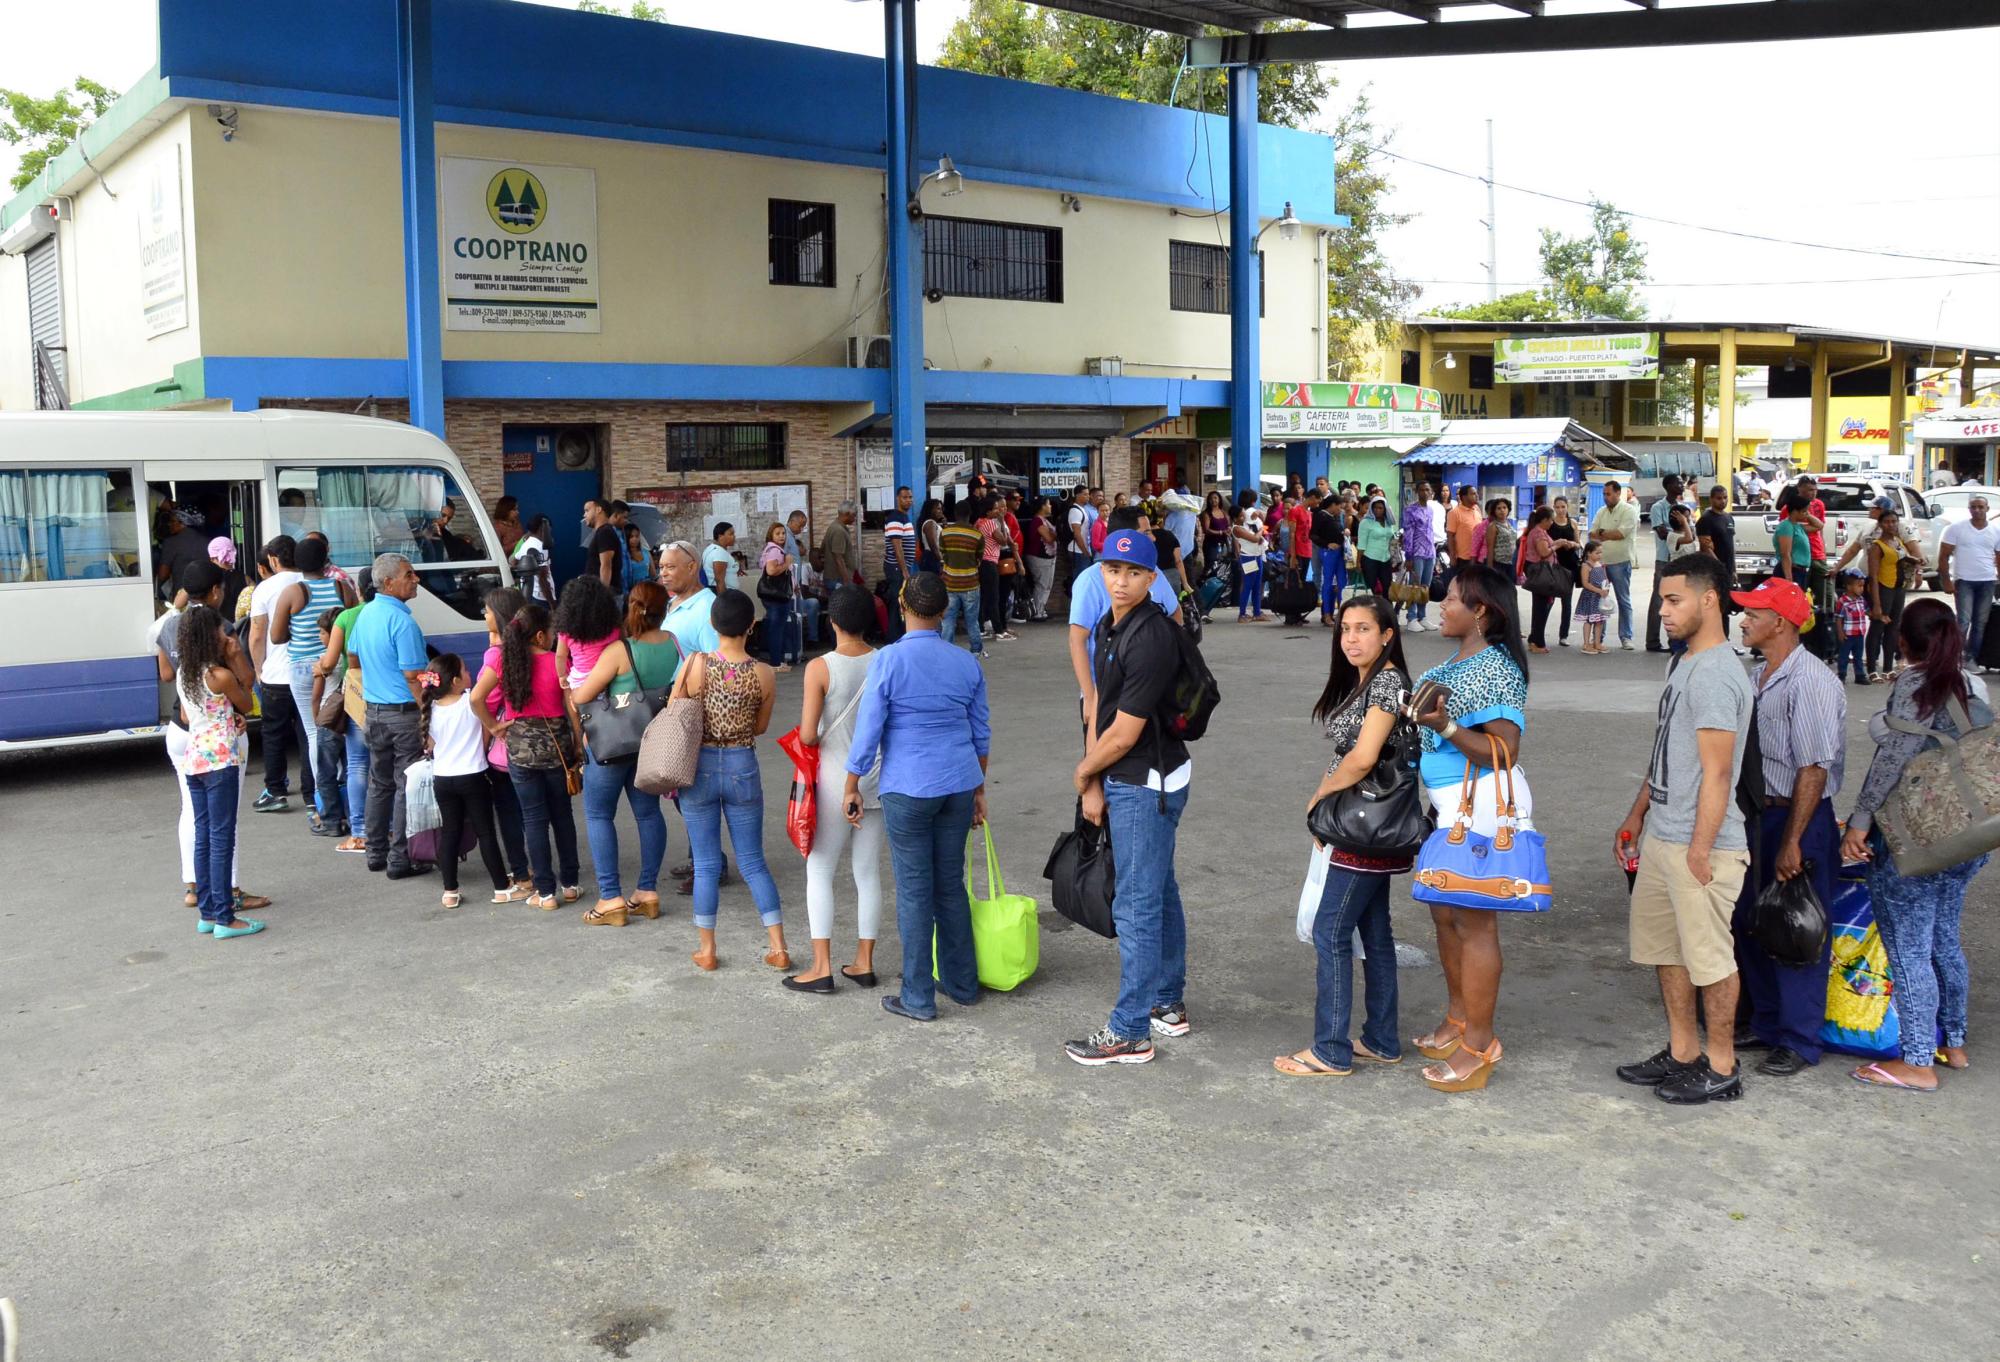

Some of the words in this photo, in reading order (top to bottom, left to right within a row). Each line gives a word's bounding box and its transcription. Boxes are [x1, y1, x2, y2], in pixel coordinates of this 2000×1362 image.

[454, 237, 588, 264] COOPTRANO
[520, 261, 552, 273] Siempre
[556, 263, 583, 275] Contigo
[455, 273, 492, 281] COOPERATIVA
[474, 283, 500, 291] MULTIPLE
[508, 284, 543, 292] TRANSPORTE
[1608, 336, 1642, 350] TOURS
[1532, 355, 1564, 363] SANTIAGO
[1569, 354, 1596, 362] PUERTO
[1597, 353, 1618, 361] PLATA
[1306, 411, 1350, 420] CAFETERIA
[1309, 422, 1347, 432] ALMONTE
[1963, 423, 2000, 436] CAFE
[935, 454, 964, 464] ENVIOS
[1041, 475, 1086, 487] BOLETERIA
[1117, 537, 1131, 552] C
